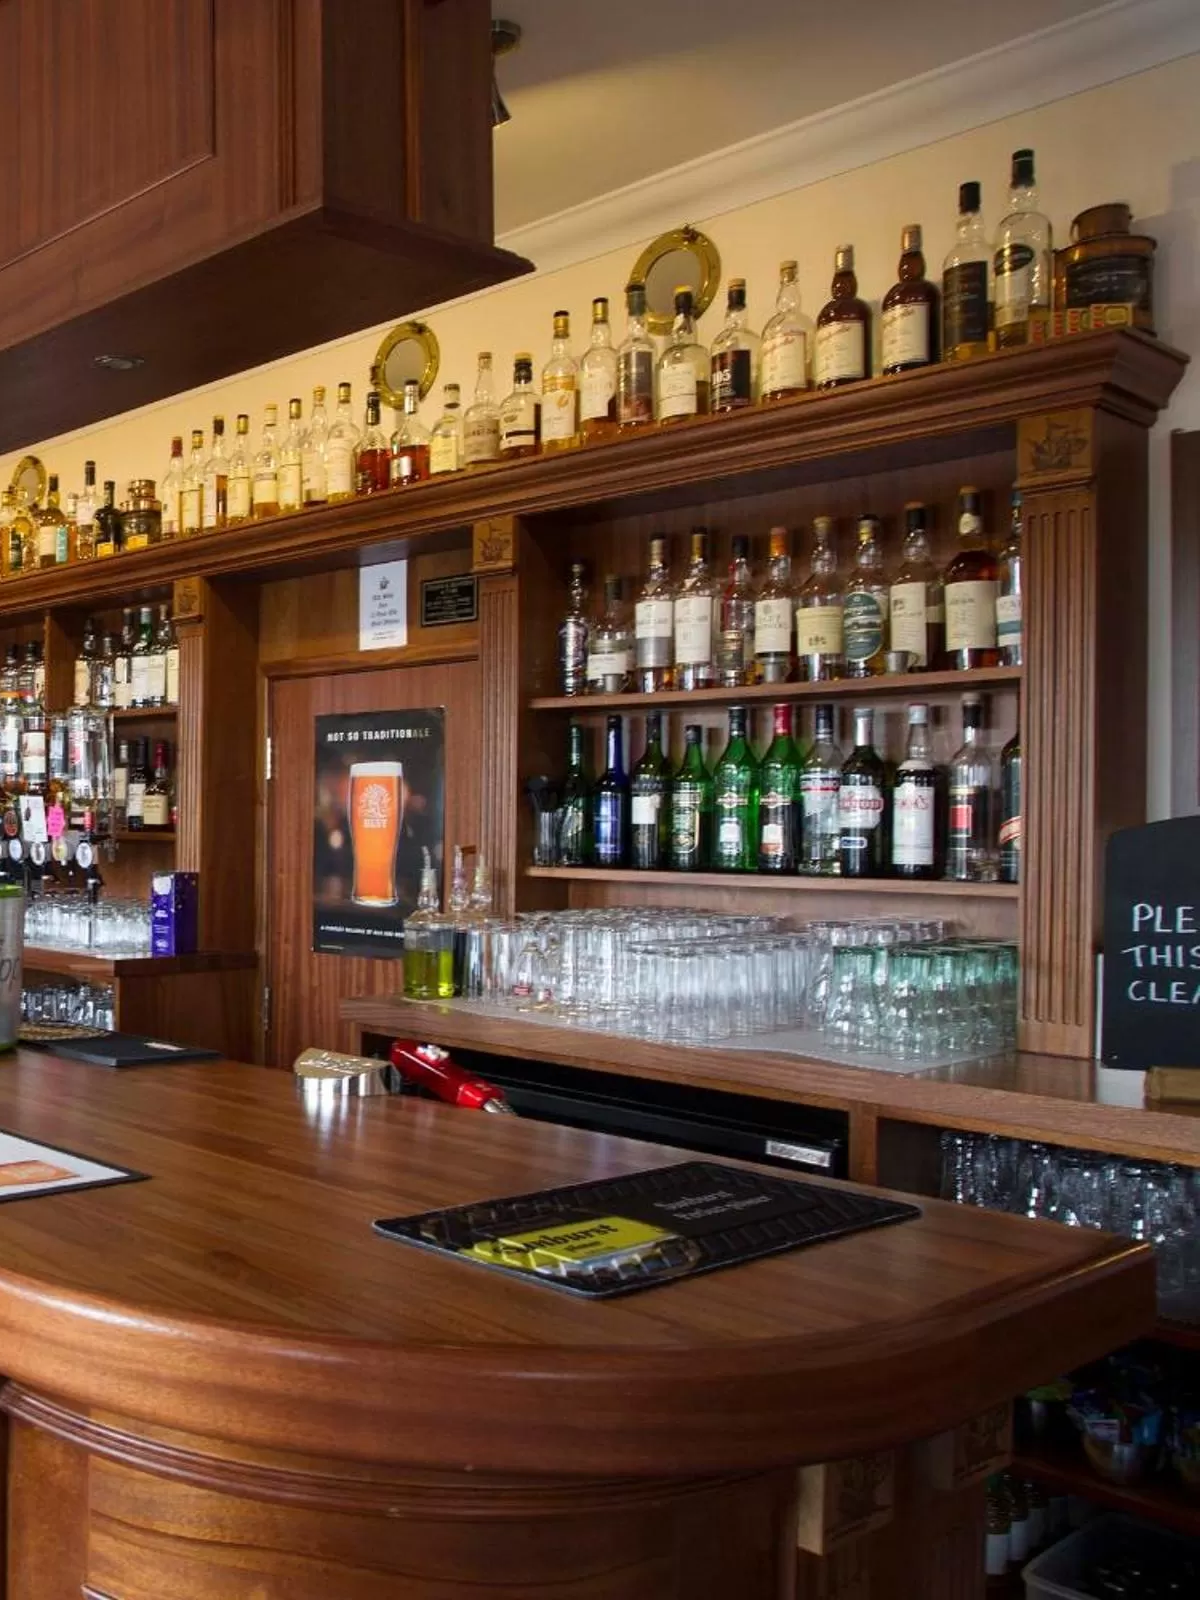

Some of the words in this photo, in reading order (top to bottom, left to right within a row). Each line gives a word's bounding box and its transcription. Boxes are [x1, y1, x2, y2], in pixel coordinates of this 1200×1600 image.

[327, 733, 344, 742] NOT
[348, 732, 359, 741] SO
[1132, 903, 1200, 932] PLE
